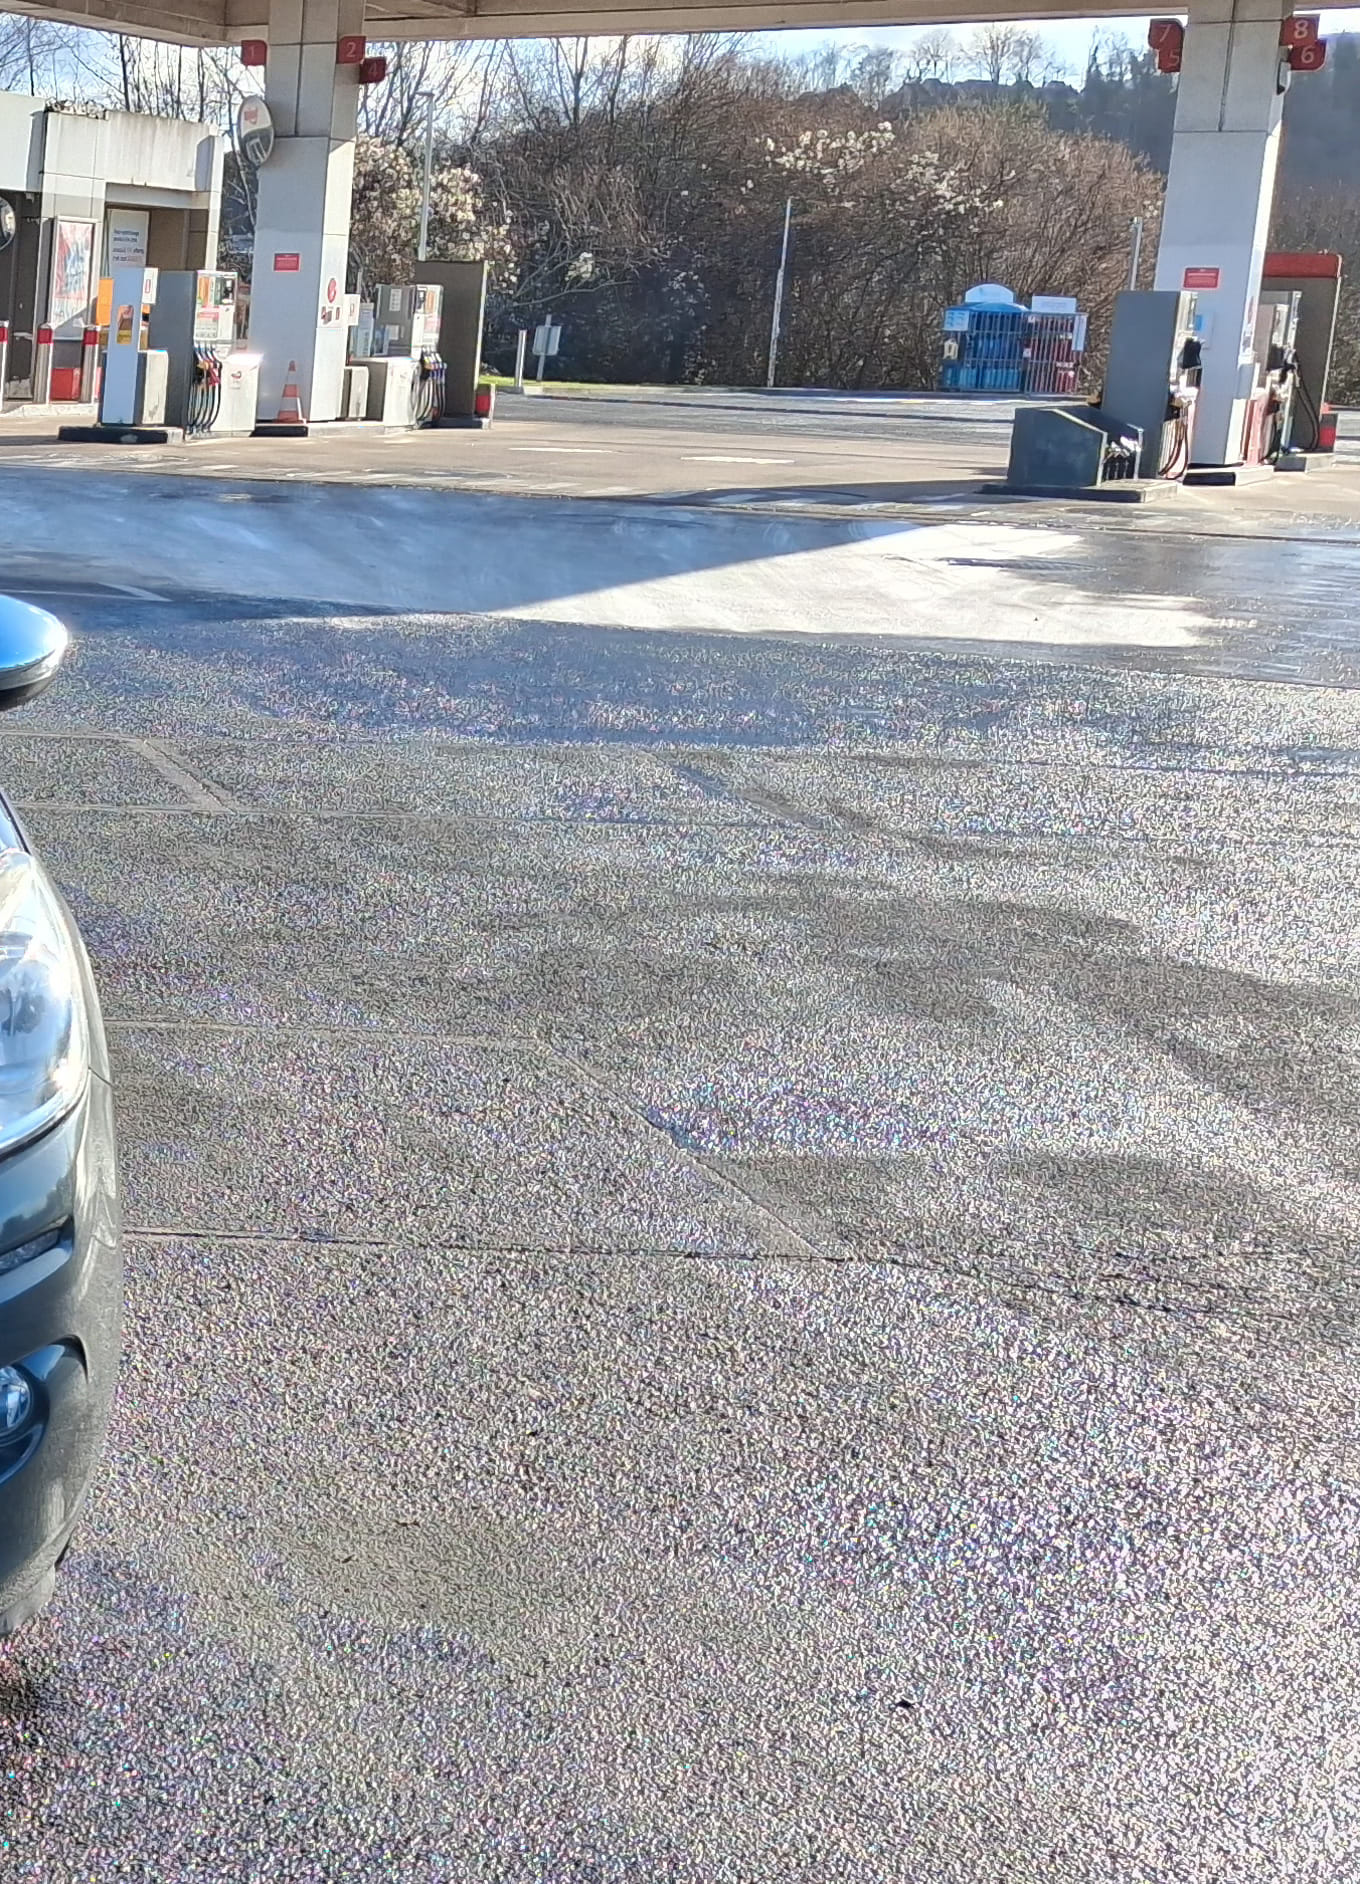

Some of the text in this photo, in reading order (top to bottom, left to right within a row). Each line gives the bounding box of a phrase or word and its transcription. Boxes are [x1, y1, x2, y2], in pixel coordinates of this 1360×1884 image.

[1156, 23, 1171, 43] 7
[1293, 19, 1309, 39] 8
[345, 41, 357, 58] 2
[1300, 45, 1315, 64] 6
[368, 62, 378, 74] 4
